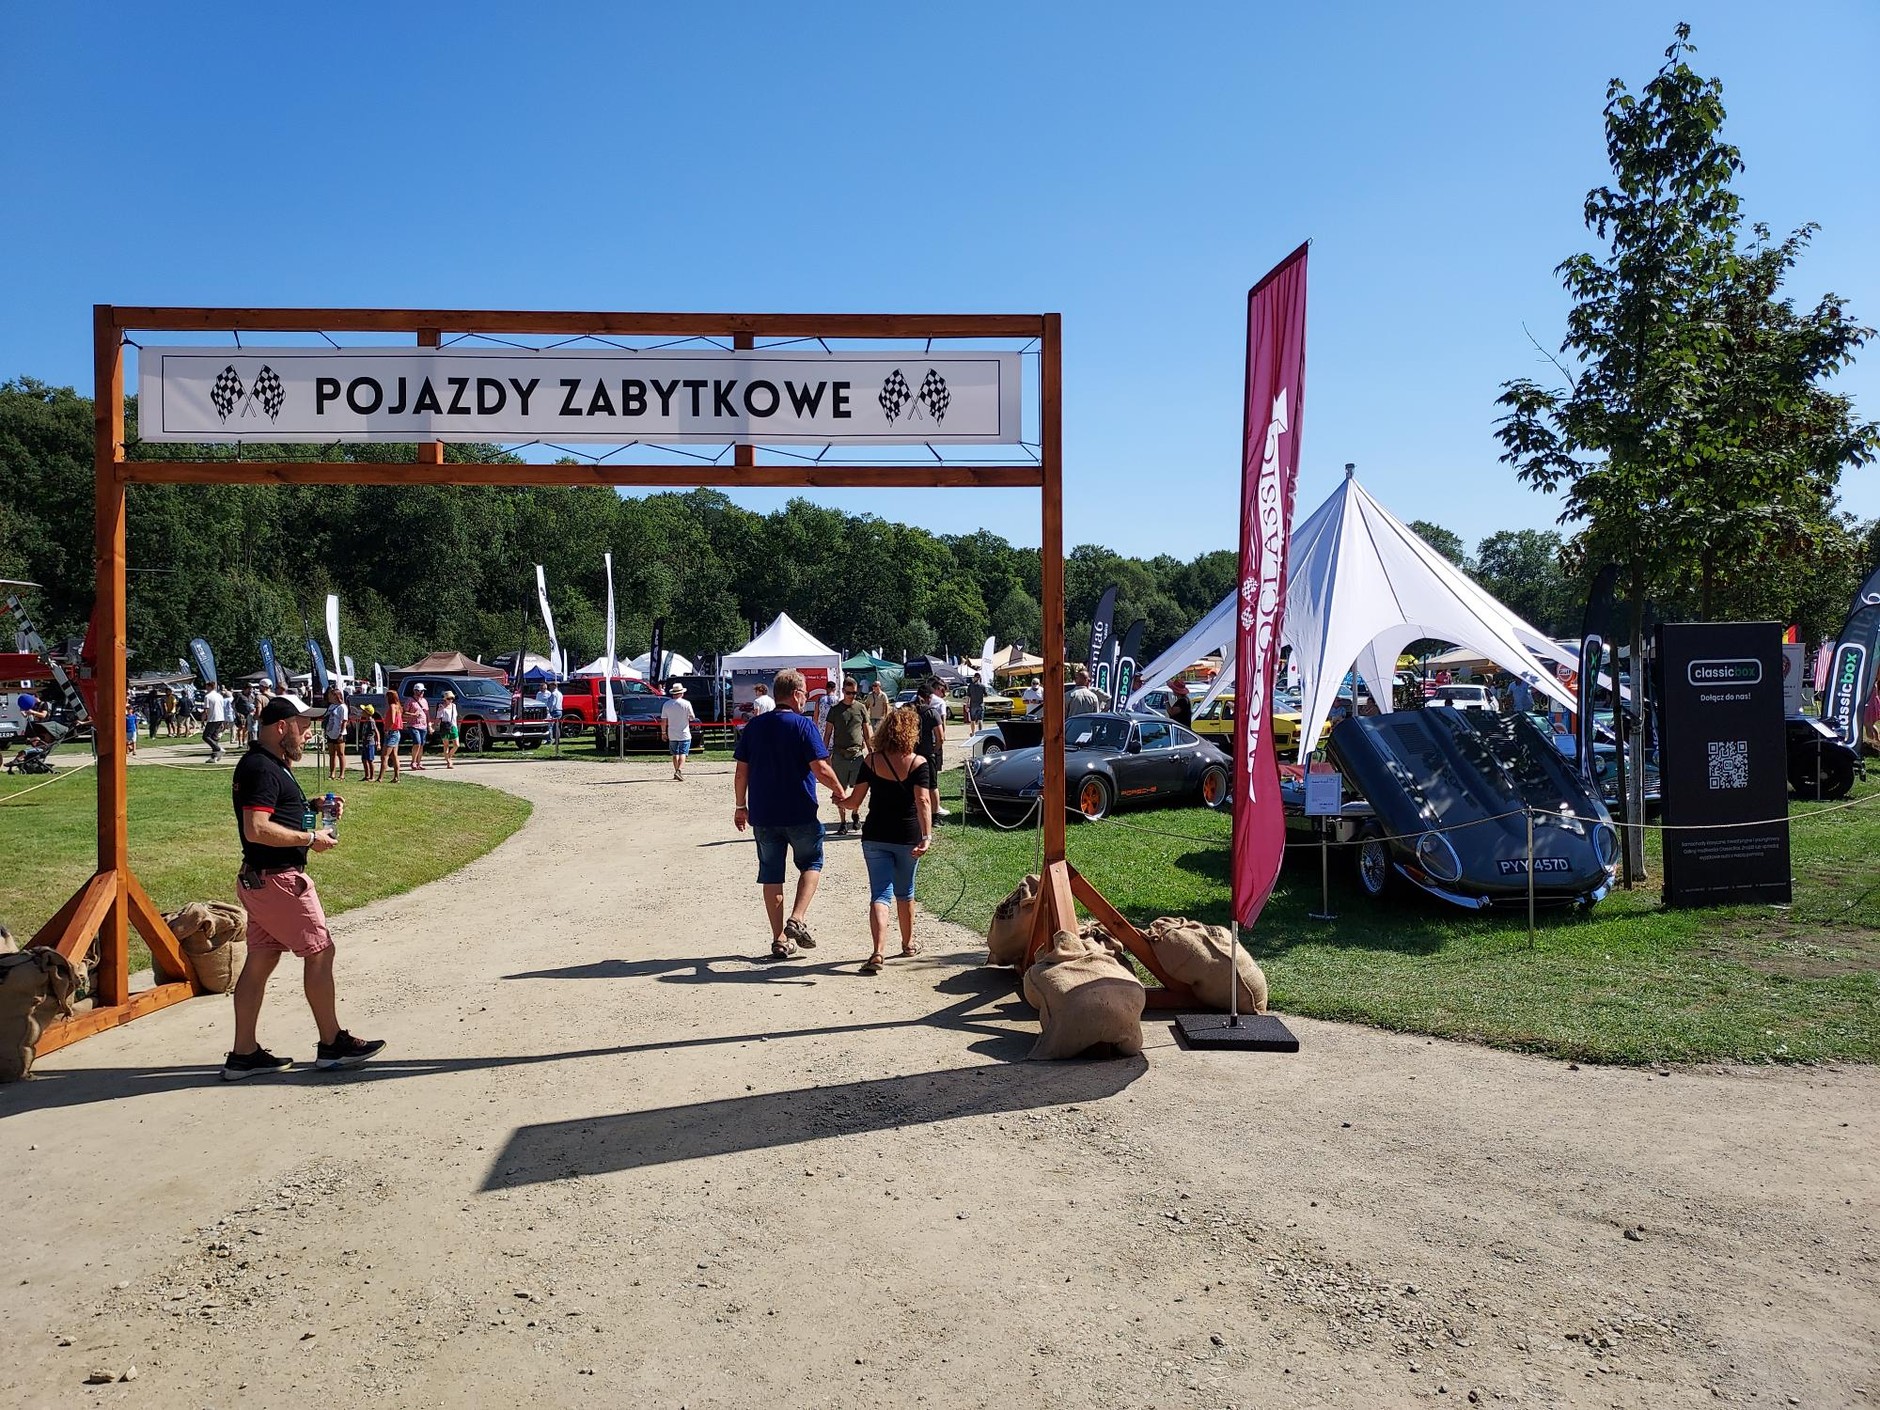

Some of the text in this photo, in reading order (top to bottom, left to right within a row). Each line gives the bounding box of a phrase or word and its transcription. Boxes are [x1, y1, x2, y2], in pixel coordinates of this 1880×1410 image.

[315, 376, 853, 420] POJAZDY ZABYTKOWE
[1694, 665, 1756, 678] classicbox
[1700, 692, 1751, 702] Dołącz do nas!
[1500, 858, 1569, 874] PYY 457D
